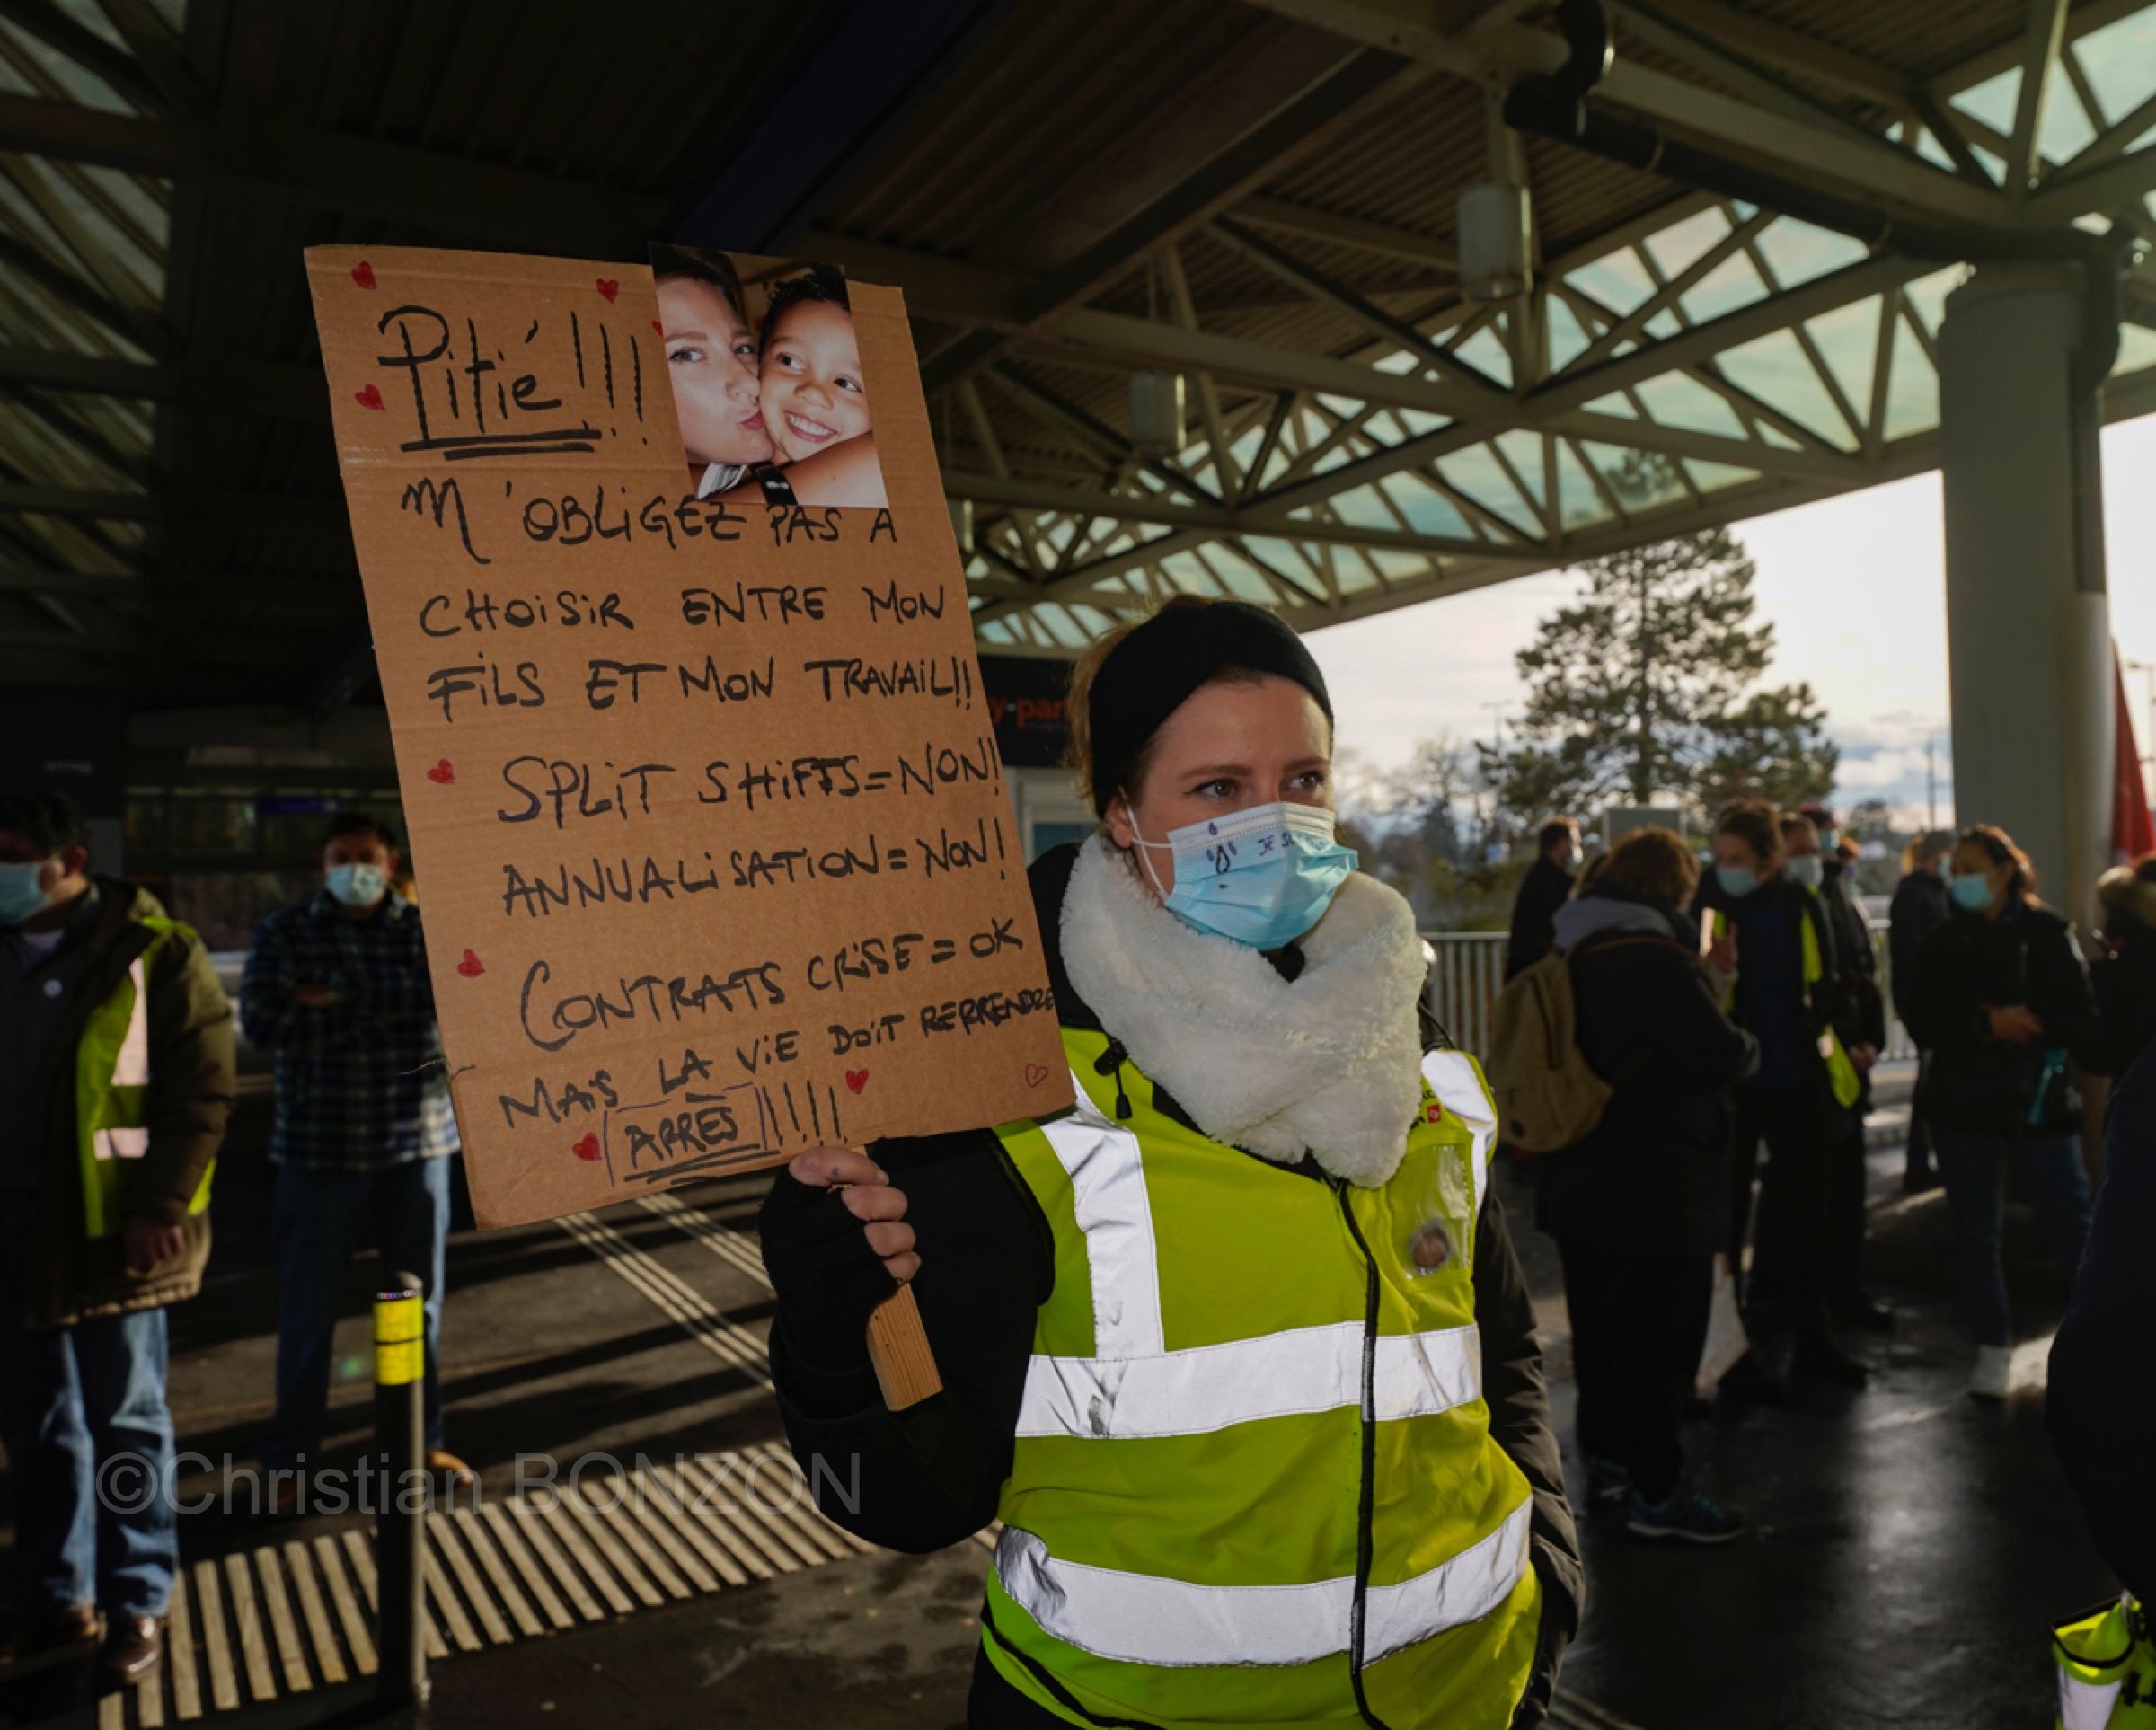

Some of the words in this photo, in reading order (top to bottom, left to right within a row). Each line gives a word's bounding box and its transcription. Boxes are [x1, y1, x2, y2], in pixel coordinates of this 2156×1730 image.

[765, 504, 843, 547] PAS
[868, 508, 897, 543] A
[680, 581, 828, 627] ENTRE
[861, 579, 944, 626] MON
[585, 658, 667, 710] ET
[678, 654, 774, 703] MON
[658, 1048, 714, 1096] LA
